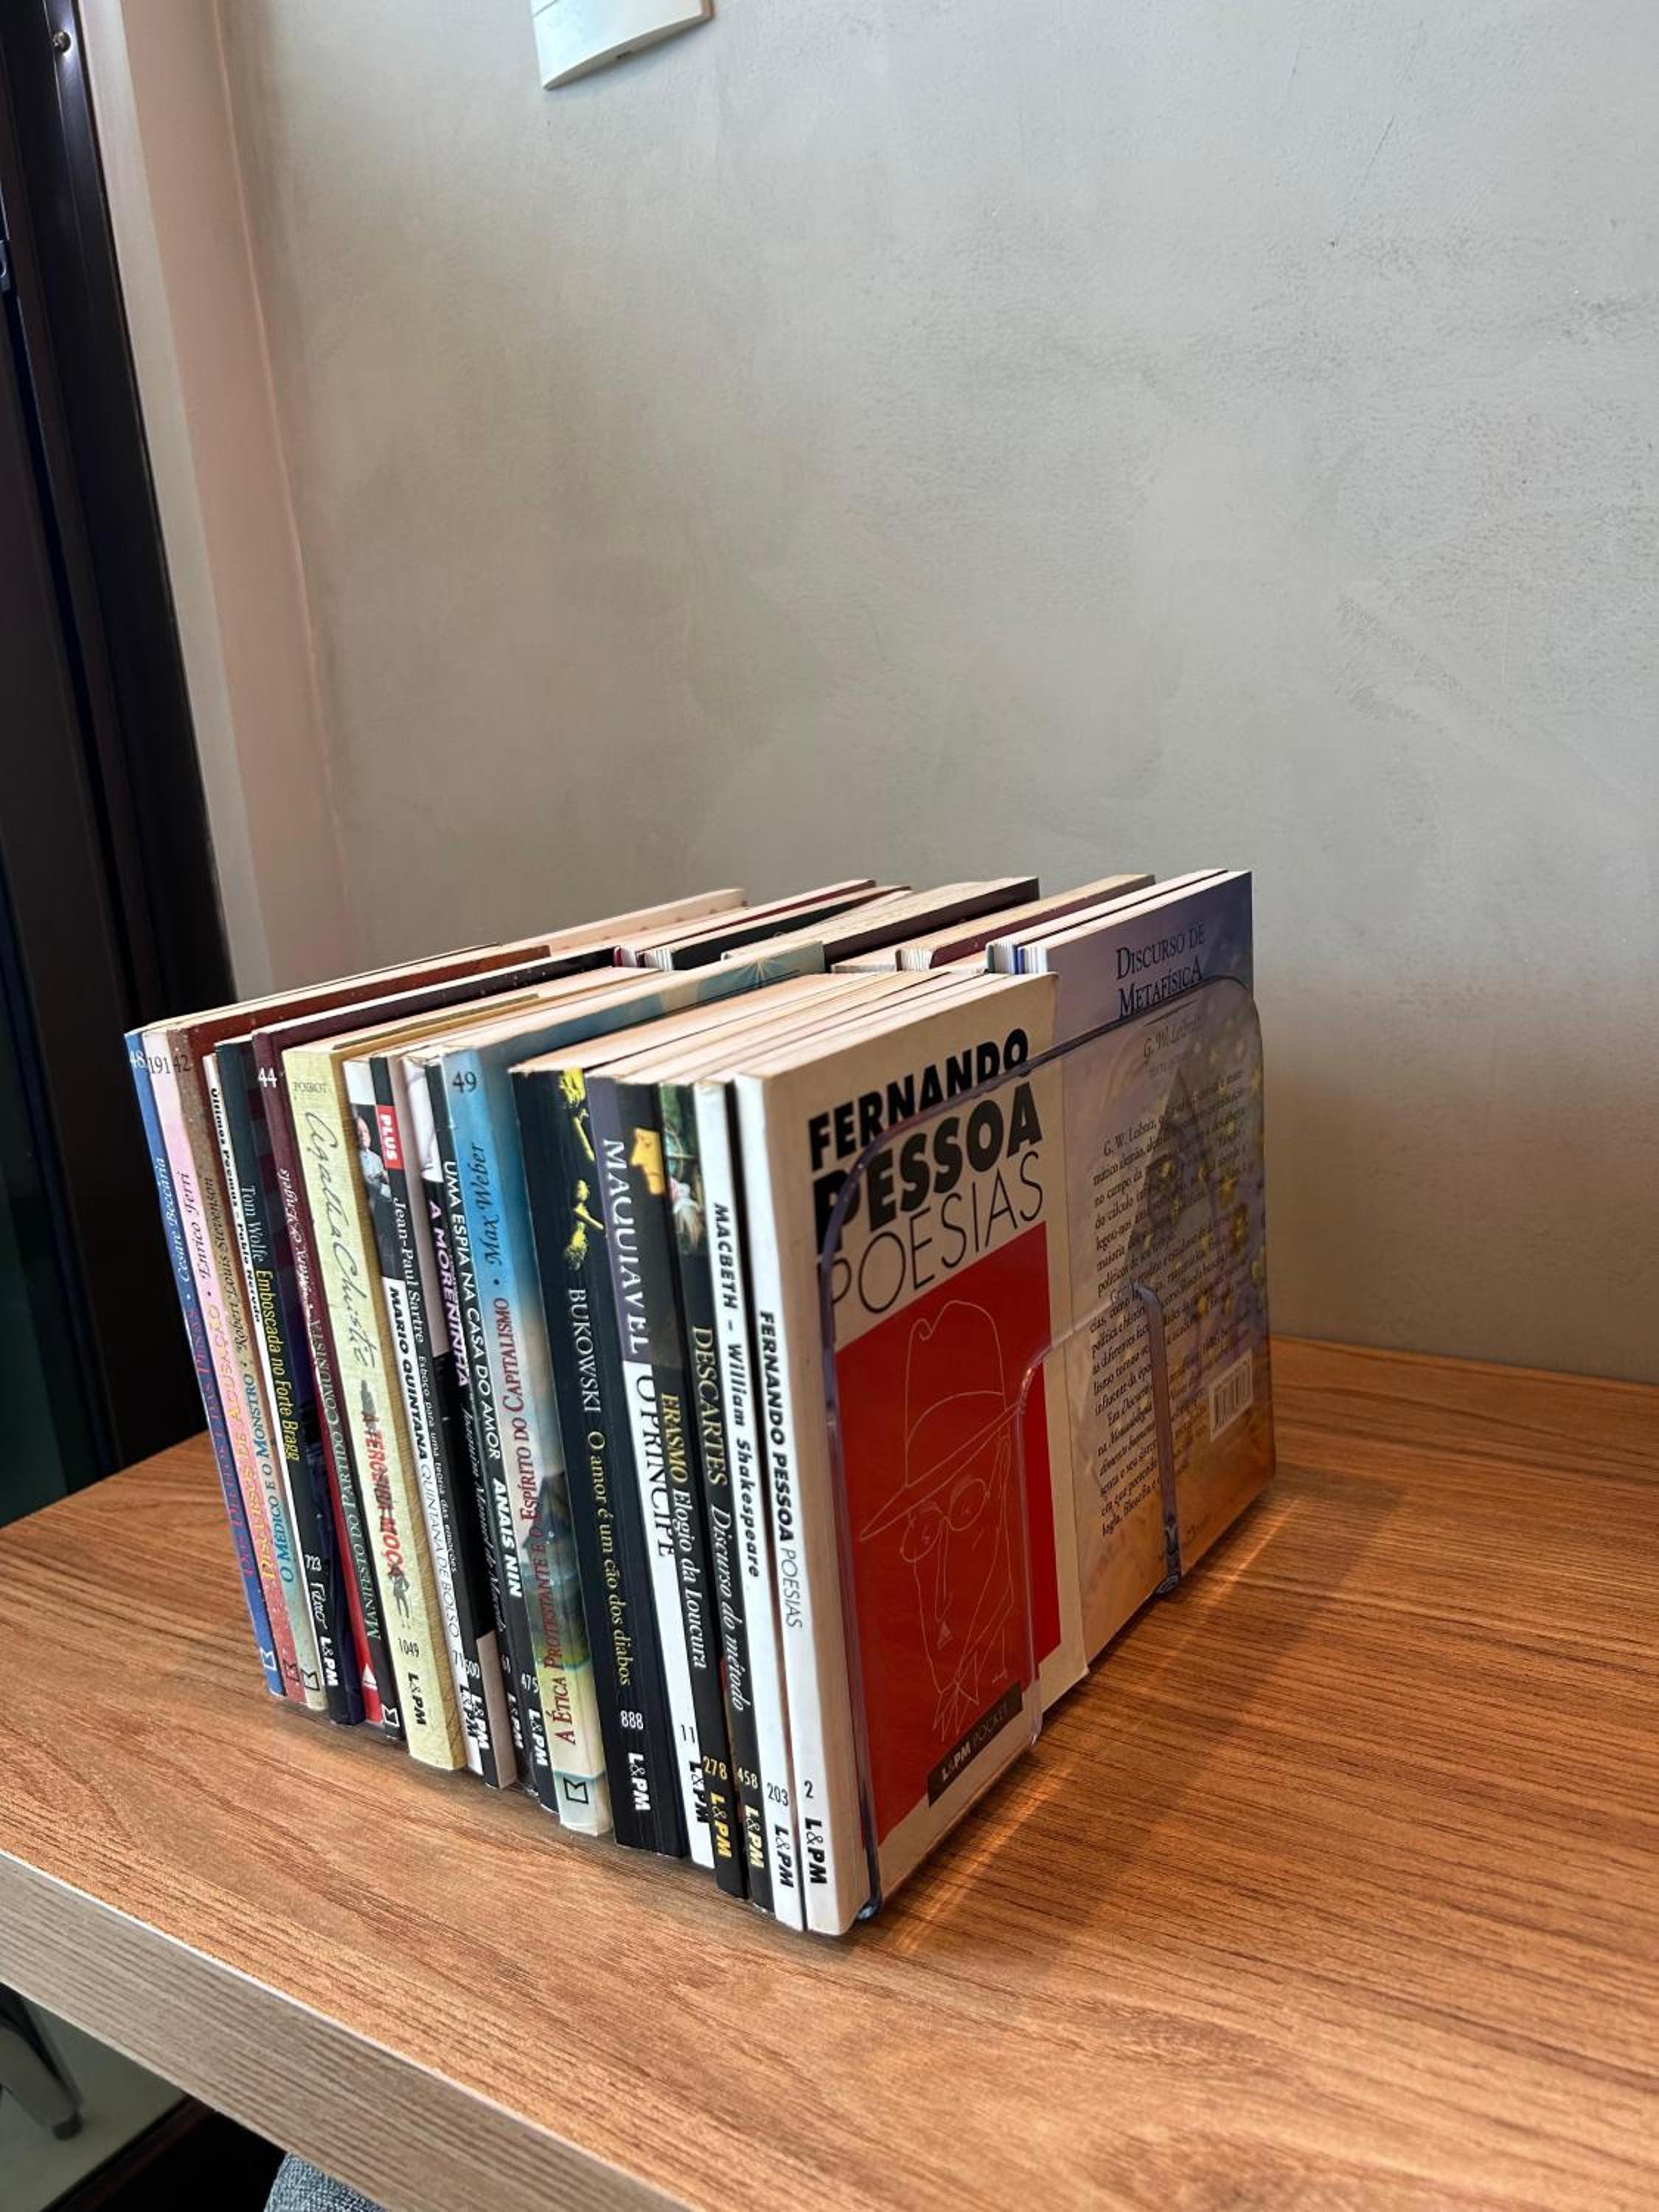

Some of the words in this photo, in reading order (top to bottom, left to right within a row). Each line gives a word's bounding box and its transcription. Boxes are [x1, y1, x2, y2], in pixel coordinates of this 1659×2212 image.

[1189, 923, 1205, 949] DE
[148, 1056, 170, 1074] 191
[258, 1067, 278, 1089] 44
[453, 1071, 478, 1094] 49
[808, 1028, 1029, 1172] FERNANDO
[380, 1113, 397, 1161] PLUS
[442, 1161, 462, 1207] UMA
[467, 1142, 493, 1211] Weber
[813, 1082, 1043, 1254] PESSOA
[241, 1185, 256, 1217] Tom
[429, 1200, 442, 1220] A
[191, 1222, 211, 1280] Enrico
[248, 1222, 268, 1262] Wolfe
[451, 1213, 471, 1266] ESPIA
[480, 1214, 502, 1267] Max
[602, 1139, 650, 1354] MAQUIAVEL
[713, 1203, 738, 1310] MACBETH
[817, 1152, 1043, 1343] POESIAS
[393, 1197, 420, 1286] Jean-Paul
[408, 1289, 424, 1343] Sartre
[459, 1272, 476, 1301] NA
[256, 1270, 284, 1354] Emboscada
[389, 1287, 408, 1354] MARIO
[434, 1227, 470, 1387] MORENINHA
[465, 1307, 485, 1358] CASA
[271, 1357, 285, 1375] no
[493, 1297, 524, 1413] CAPITALISMO
[568, 1288, 602, 1413] BUKOWSKI
[274, 1380, 293, 1416] Forte
[475, 1364, 490, 1397] DO
[636, 1374, 657, 1402] O
[728, 1343, 747, 1427] William
[759, 1310, 787, 1447] FERNANDO
[243, 1373, 271, 1458] MONSTRO
[402, 1358, 428, 1459] QUINTANA
[481, 1402, 501, 1460] AMOR
[512, 1417, 532, 1443] DO
[691, 1326, 728, 1487] DESCARTES
[282, 1419, 300, 1462] Bragg
[588, 1430, 605, 1450] O
[661, 1392, 689, 1484] ERASMO
[262, 1463, 273, 1476] O
[265, 1480, 276, 1490] E
[330, 1431, 357, 1509] PARTIDO
[590, 1455, 608, 1503] amor
[420, 1463, 445, 1552] QUINTANA
[493, 1478, 515, 1549] ANAIS
[597, 1507, 614, 1519] é
[672, 1488, 695, 1552] Elogio
[735, 1438, 759, 1578] Shakespeare
[772, 1452, 795, 1543] PESSOA
[348, 1514, 363, 1543] DO
[599, 1525, 614, 1553] um
[709, 1503, 733, 1599] Discurso
[280, 1566, 294, 1583] O
[437, 1554, 451, 1581] DE
[503, 1554, 523, 1599] NIN
[605, 1559, 622, 1590] cão
[680, 1557, 700, 1584] da
[780, 1547, 803, 1629] POESIAS
[442, 1582, 460, 1638] BOLSO
[608, 1593, 627, 1625] dos
[685, 1589, 709, 1669] Loucura
[723, 1601, 743, 1630] do
[319, 1636, 338, 1687] L&PM
[397, 1637, 420, 1658] 1049
[613, 1628, 634, 1686] diabos
[725, 1632, 751, 1711] método
[408, 1672, 428, 1726] L&PM
[521, 1672, 540, 1694] 475
[529, 1708, 549, 1767] L&PM
[554, 1731, 577, 1745] A
[620, 1709, 644, 1731] 888
[680, 1723, 695, 1744] 11
[627, 1751, 651, 1812] L&PM
[703, 1756, 728, 1781] 278
[737, 1767, 759, 1790] 458
[767, 1782, 789, 1807] 203
[804, 1780, 815, 1798] 2
[709, 1792, 732, 1859] L&PM
[744, 1804, 765, 1869] L&PM
[804, 1816, 828, 1885] L&PM
[773, 1823, 794, 1888] L&PM
